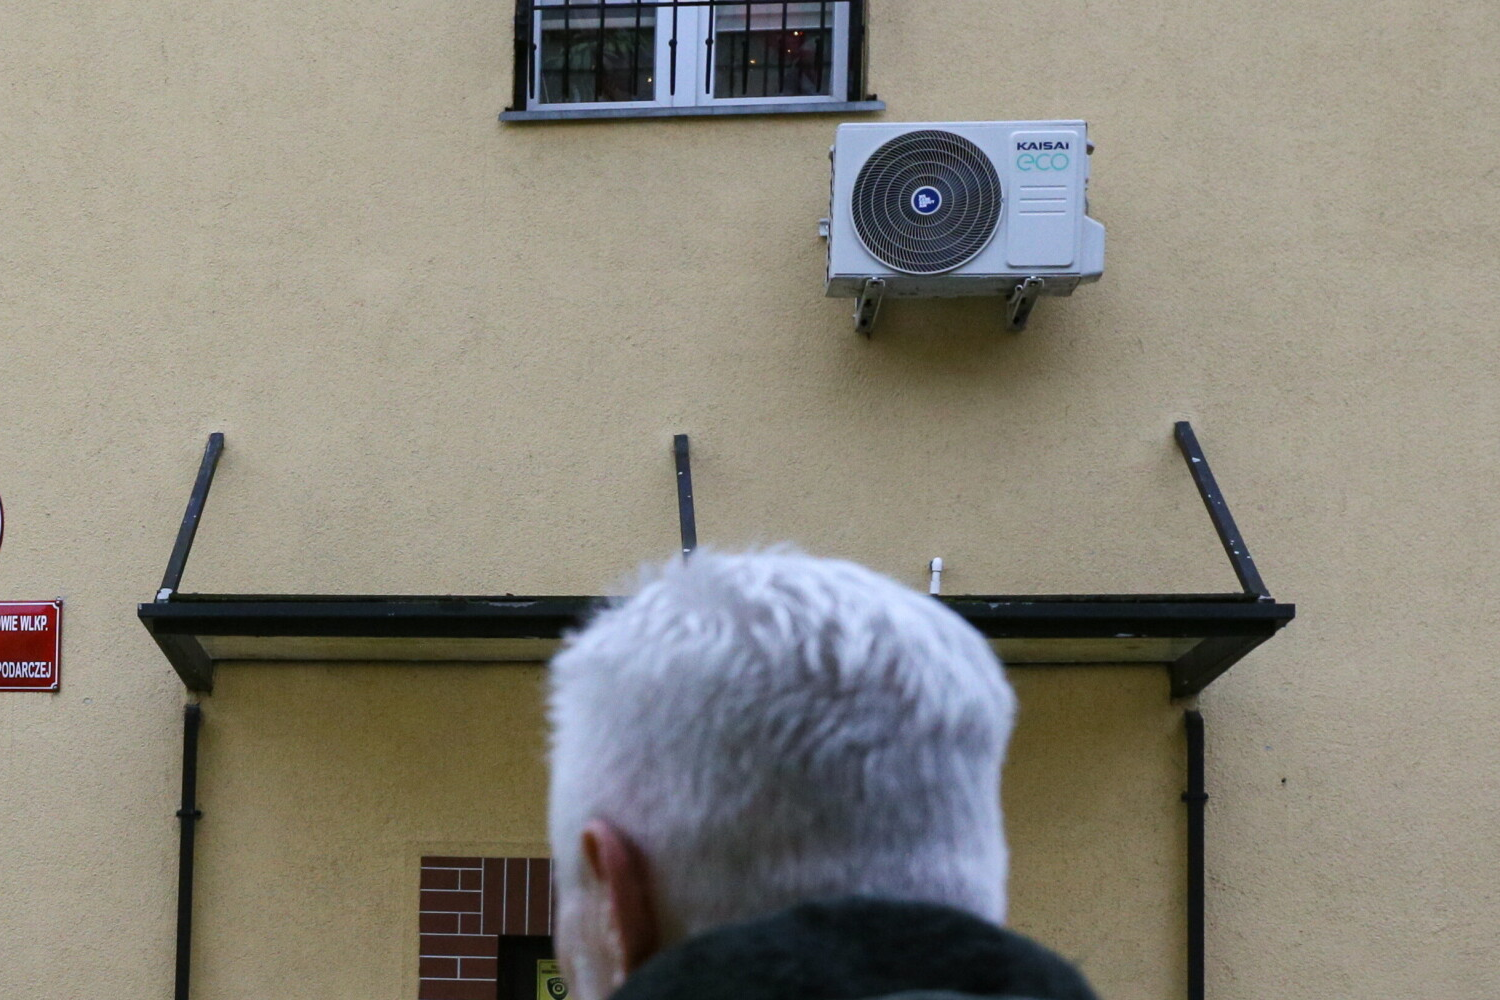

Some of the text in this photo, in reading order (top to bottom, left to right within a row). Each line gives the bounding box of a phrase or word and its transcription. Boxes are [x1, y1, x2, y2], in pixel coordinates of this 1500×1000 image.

[1016, 141, 1069, 151] KAISAI
[1016, 153, 1069, 171] eco
[20, 615, 48, 631] WLKP.
